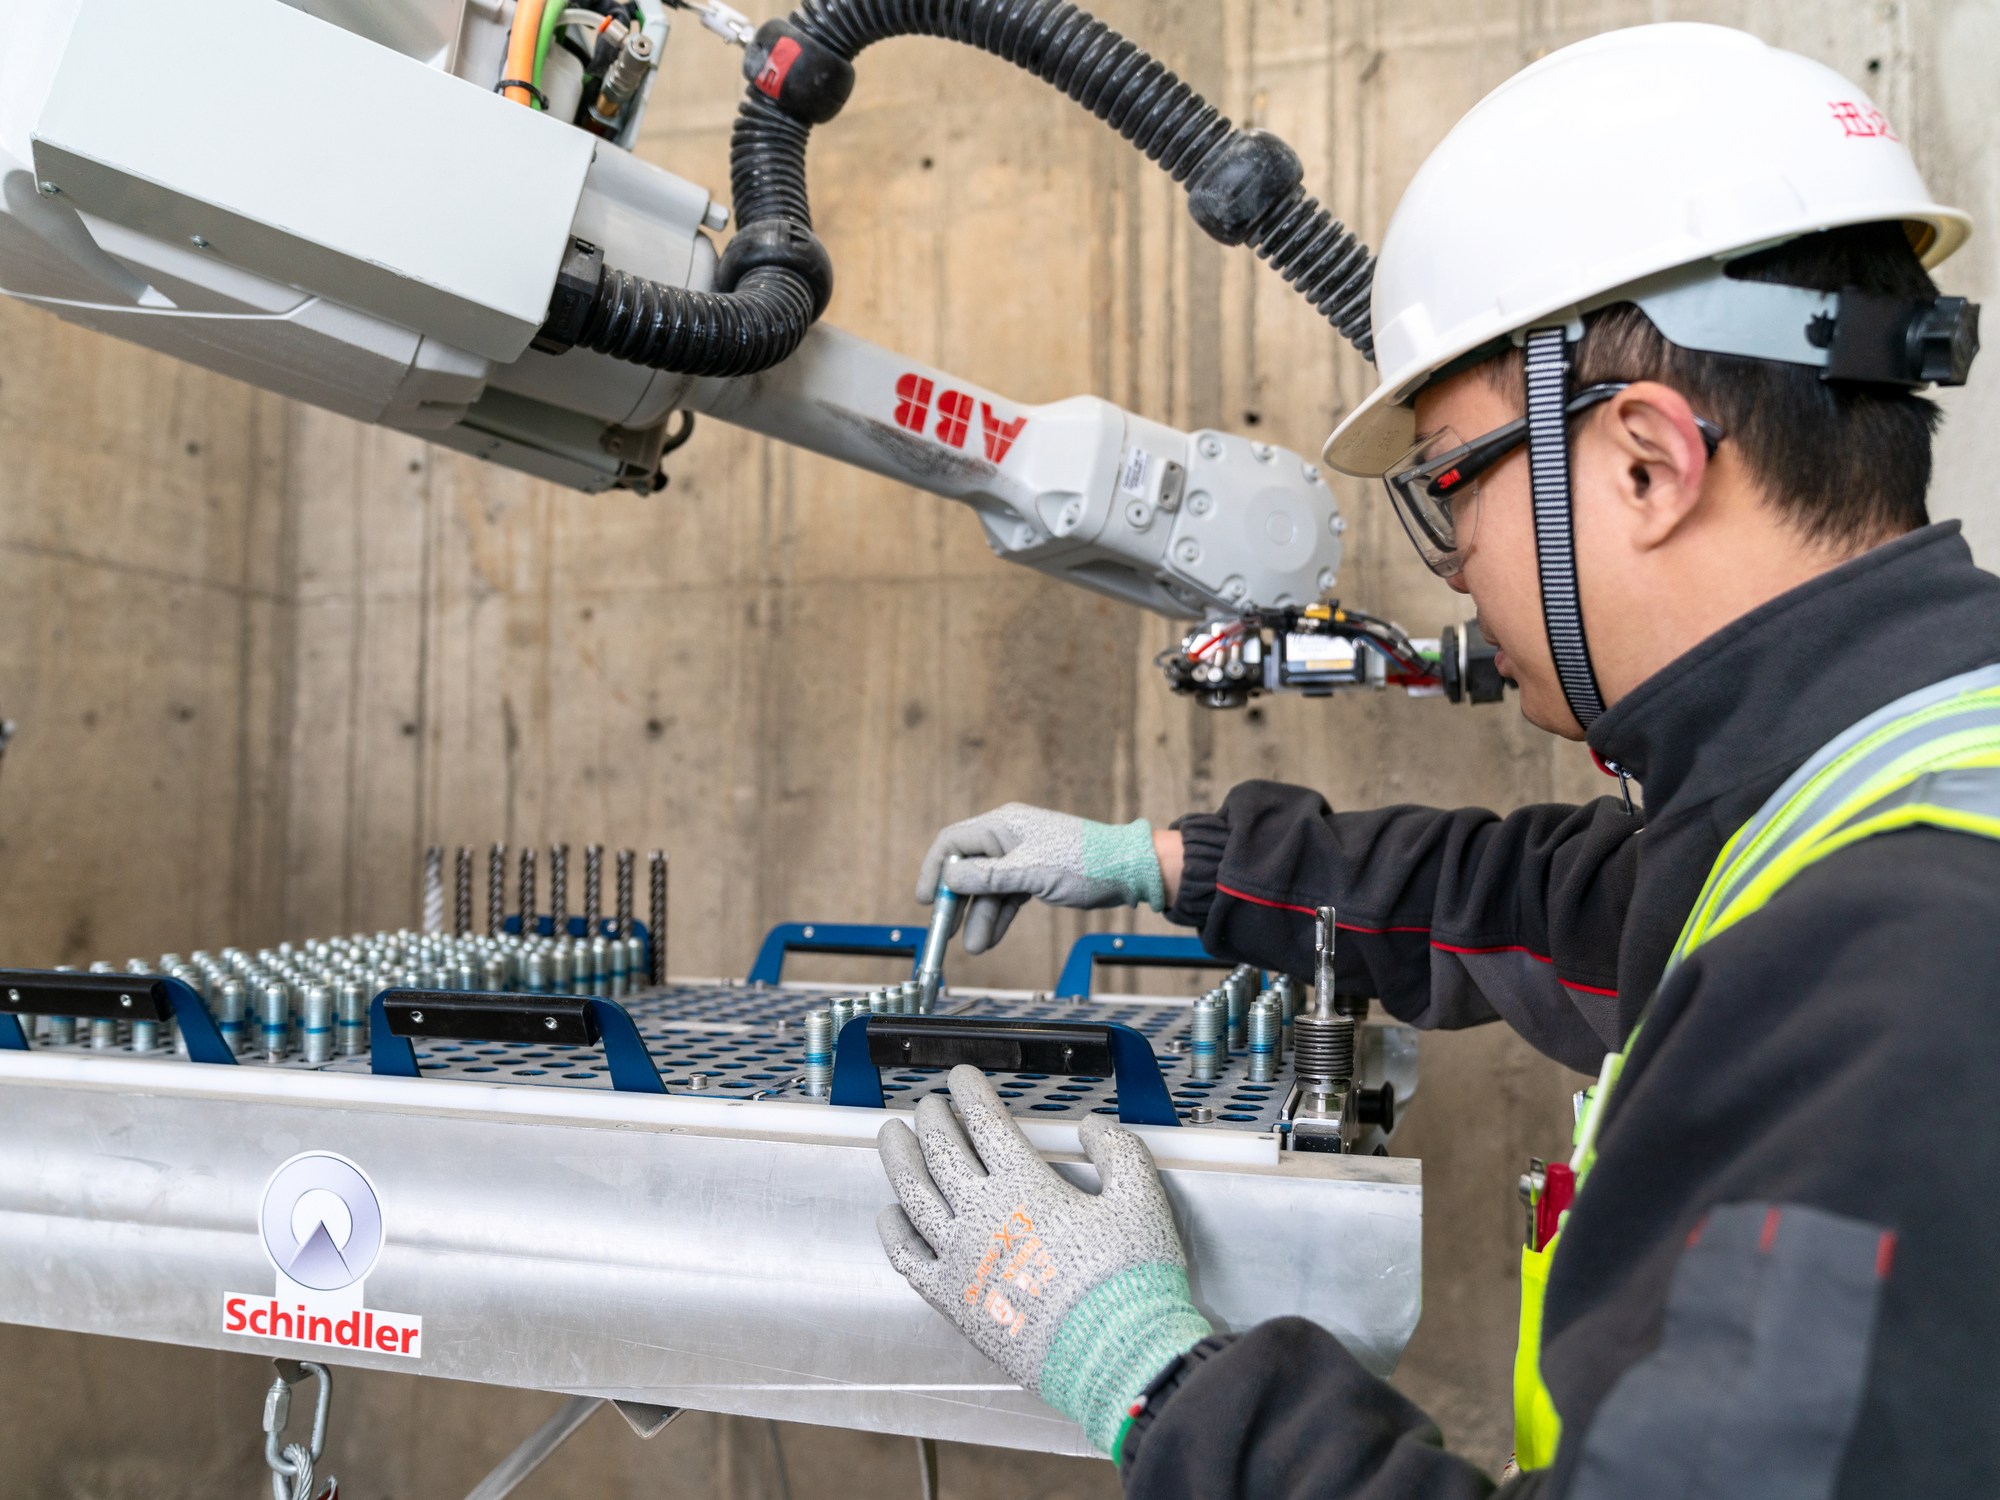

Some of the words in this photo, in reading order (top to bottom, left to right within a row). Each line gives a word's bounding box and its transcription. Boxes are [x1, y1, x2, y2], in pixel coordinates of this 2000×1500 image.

[893, 372, 1028, 465] ABB
[1437, 468, 1462, 489] 3M
[1002, 1236, 1042, 1282] N10658
[226, 1298, 418, 1354] Schindler
